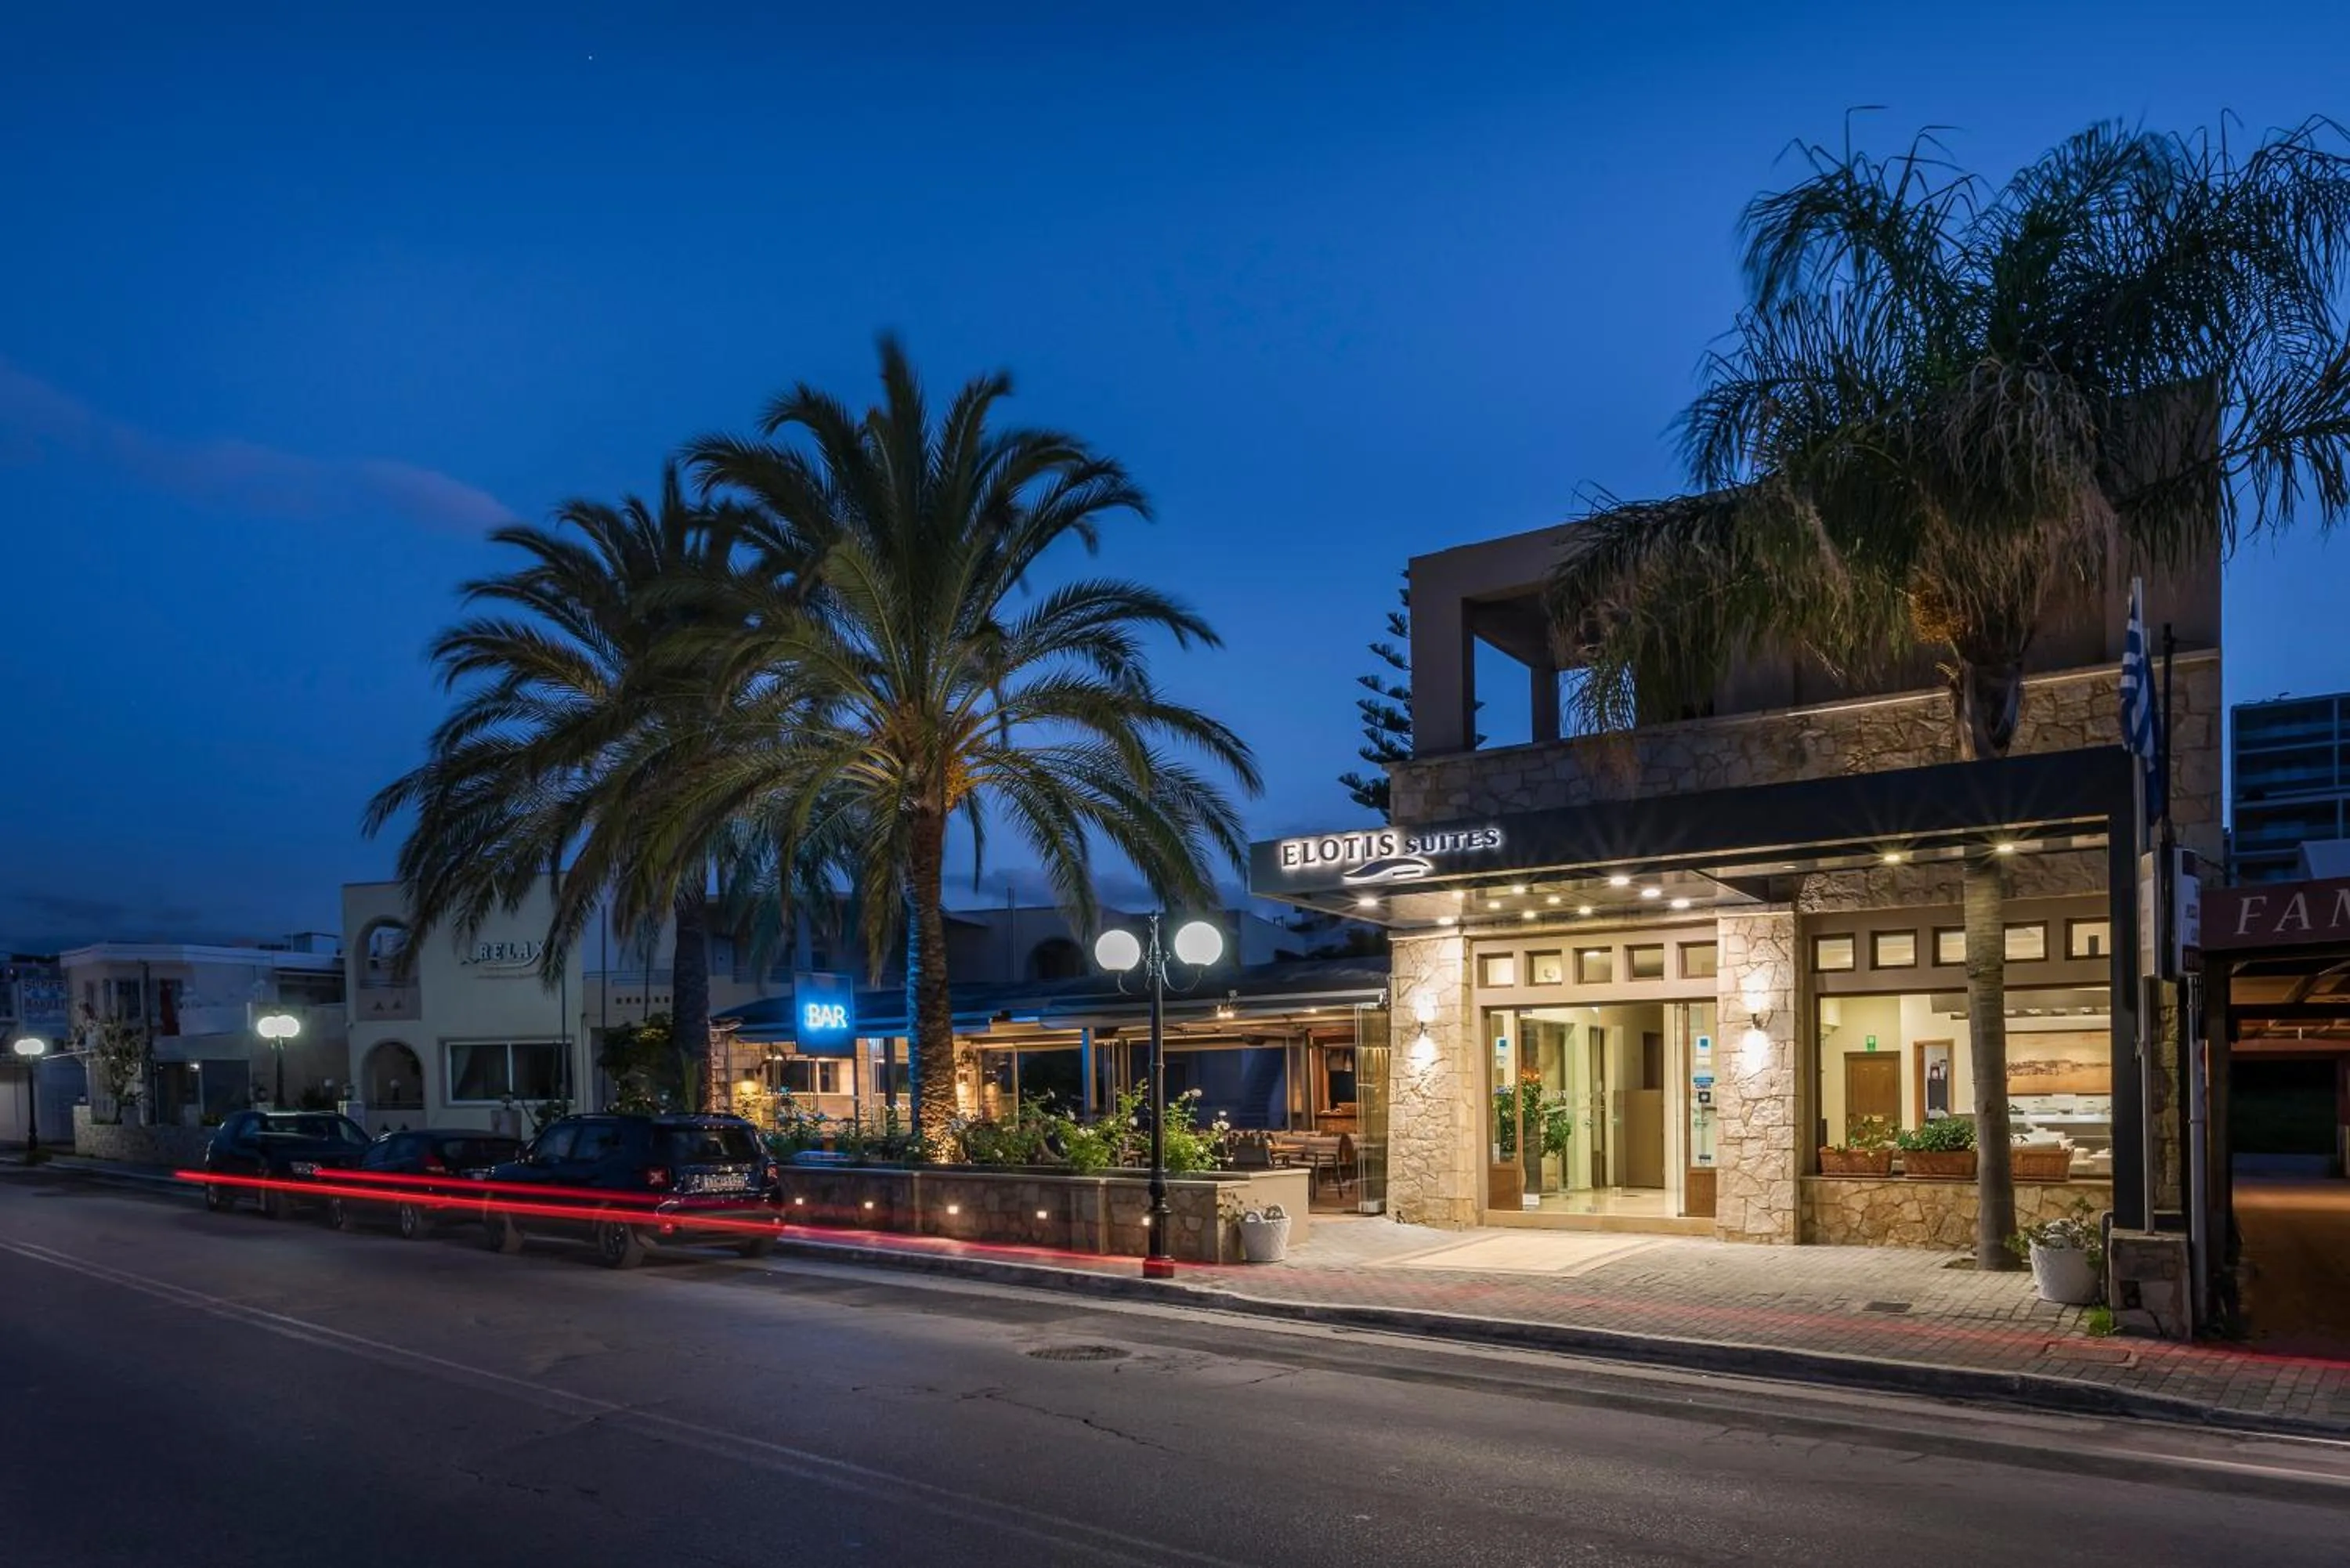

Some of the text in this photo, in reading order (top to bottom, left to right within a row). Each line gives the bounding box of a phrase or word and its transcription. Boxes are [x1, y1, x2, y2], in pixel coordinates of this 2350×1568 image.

[1282, 829, 1499, 866] ELOTIS SUITES
[807, 1003, 848, 1028] BAR
